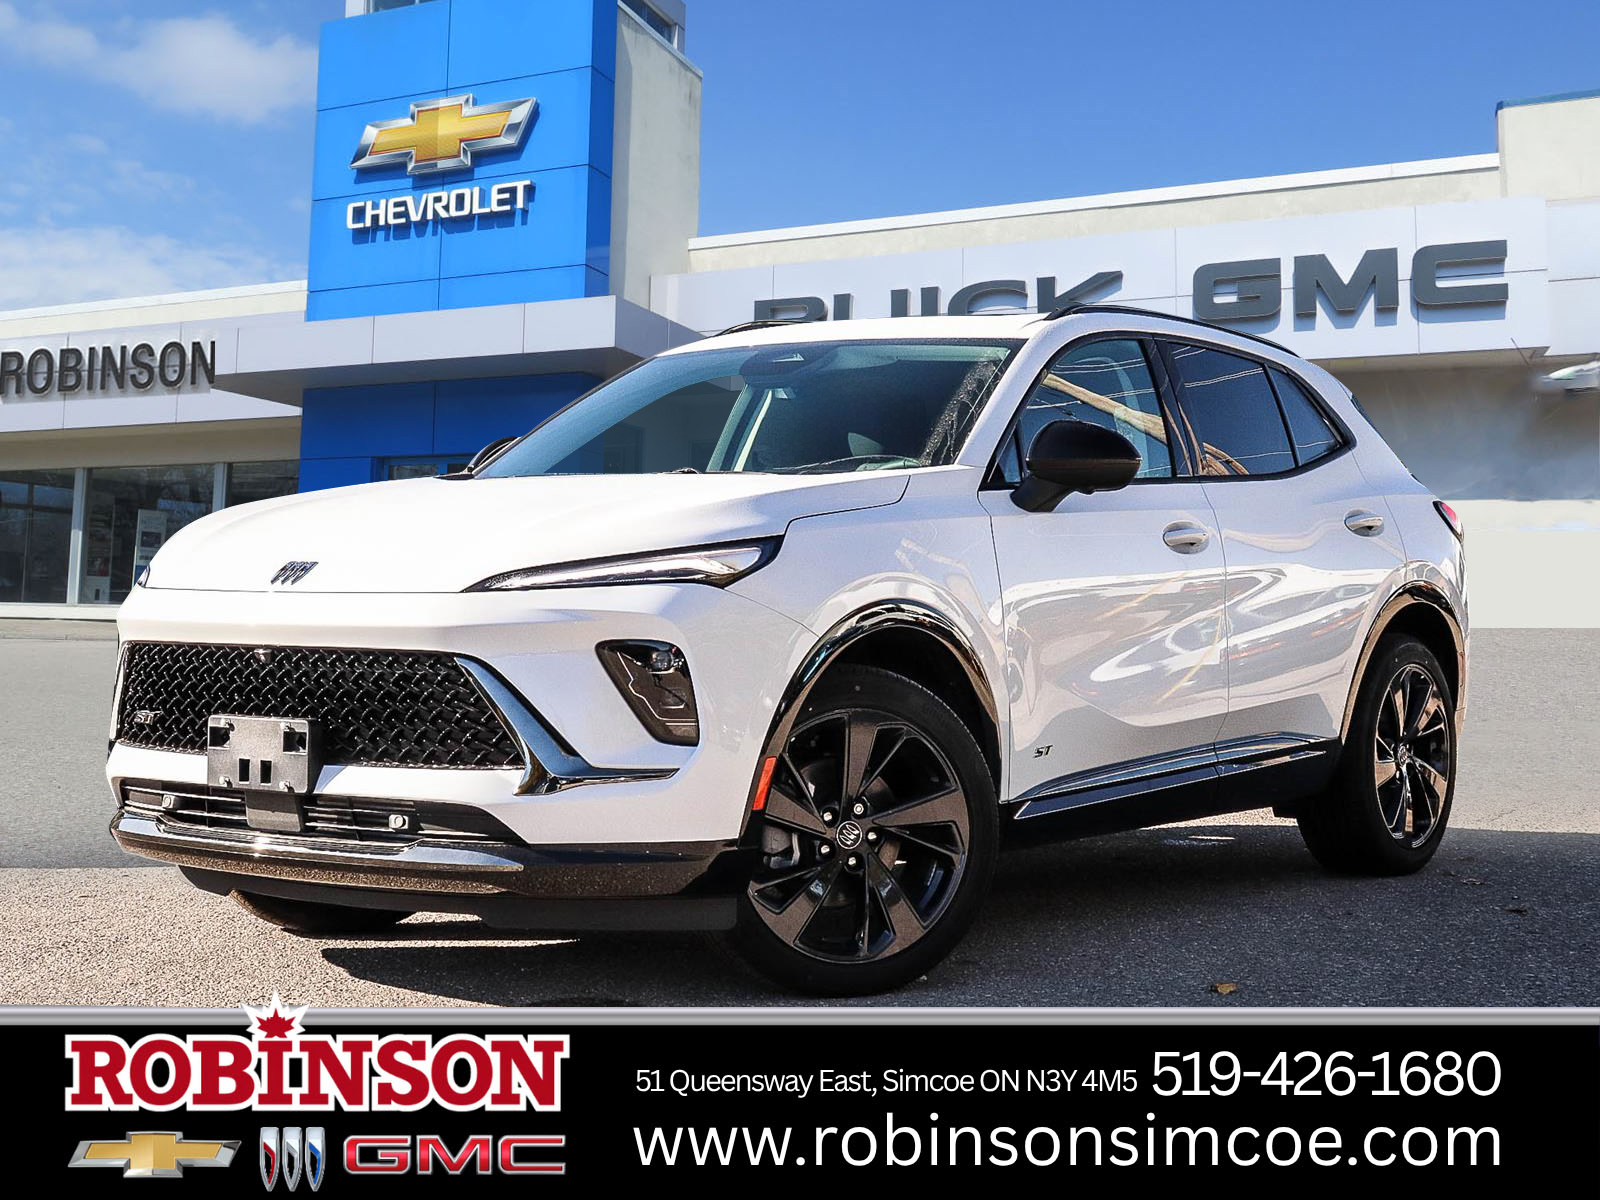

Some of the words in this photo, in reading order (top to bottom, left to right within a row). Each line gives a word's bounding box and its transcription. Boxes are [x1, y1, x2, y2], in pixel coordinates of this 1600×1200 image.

[346, 180, 534, 230] CHEVROLET
[1193, 239, 1509, 321] GMC
[0, 340, 216, 395] ROBINSON
[1033, 744, 1054, 759] ST
